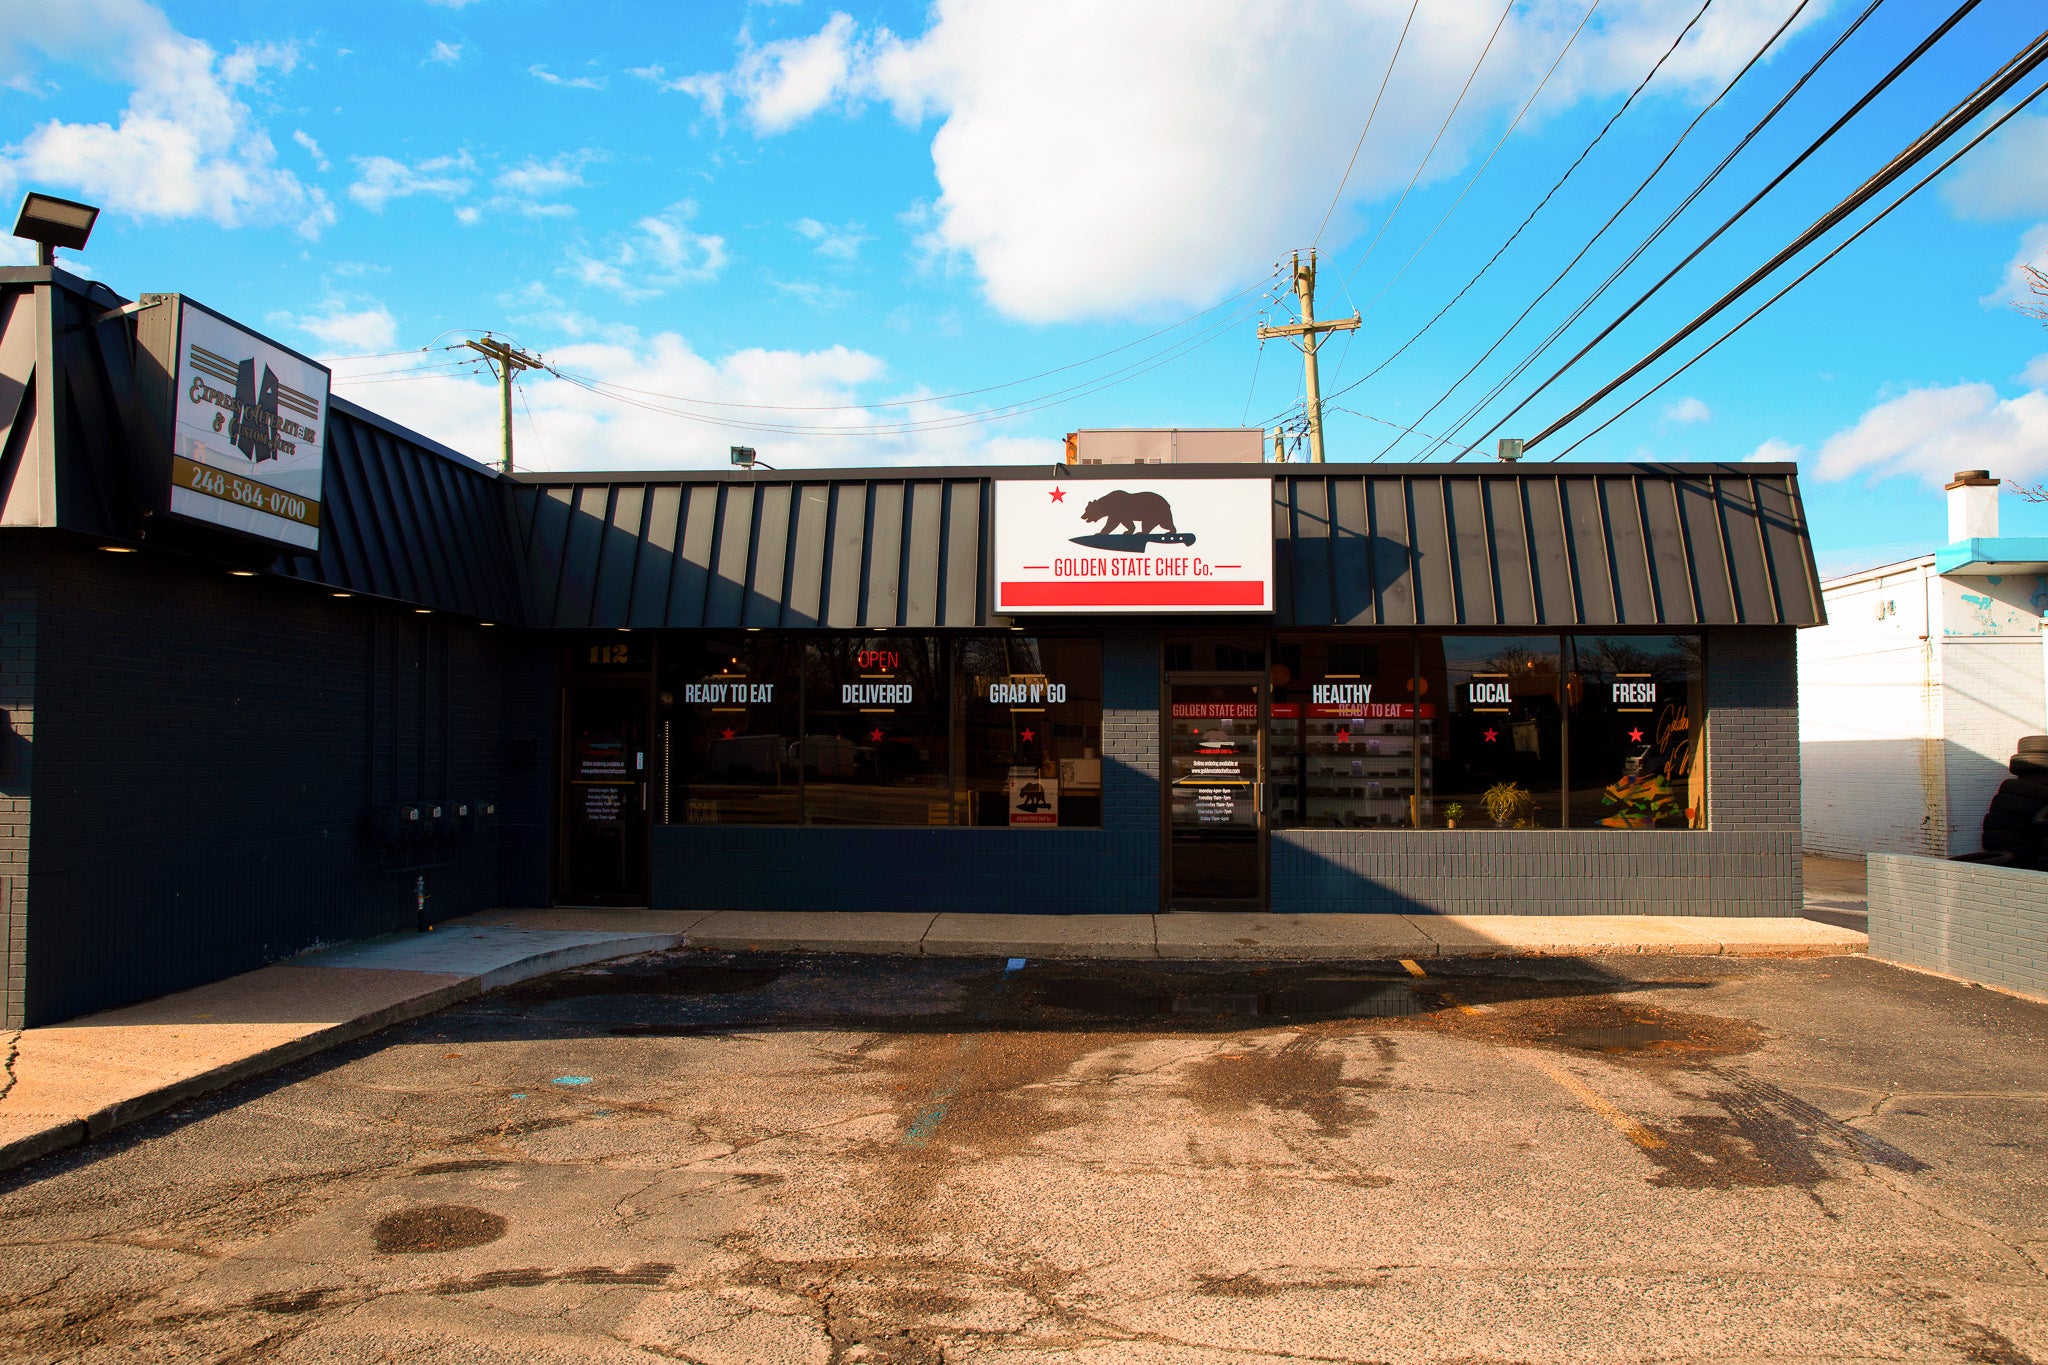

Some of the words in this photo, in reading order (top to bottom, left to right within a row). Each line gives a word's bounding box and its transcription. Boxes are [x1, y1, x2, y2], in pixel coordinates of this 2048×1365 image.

[213, 412, 226, 432] &
[191, 467, 306, 520] 248-584-0700
[1054, 558, 1107, 577] GOLDEN
[1111, 558, 1151, 577] STATE
[1155, 558, 1189, 576] CHEF
[1193, 557, 1213, 576] Co.
[590, 644, 628, 664] 112
[859, 650, 899, 669] OPEN
[685, 684, 728, 703] READY
[730, 684, 748, 703] TO
[750, 684, 774, 703] EAT
[842, 684, 913, 704] DELIVERED
[989, 683, 1027, 703] GRAB
[1047, 683, 1066, 703] GO
[1312, 684, 1372, 704] HEALTHY
[1469, 683, 1512, 703] LOCAL
[1612, 683, 1656, 703] FRESH
[1172, 704, 1207, 717] GOLDEN
[1209, 704, 1235, 717] STATE
[1338, 703, 1369, 717] READY
[1371, 703, 1384, 717] TO
[1385, 703, 1402, 717] EAT
